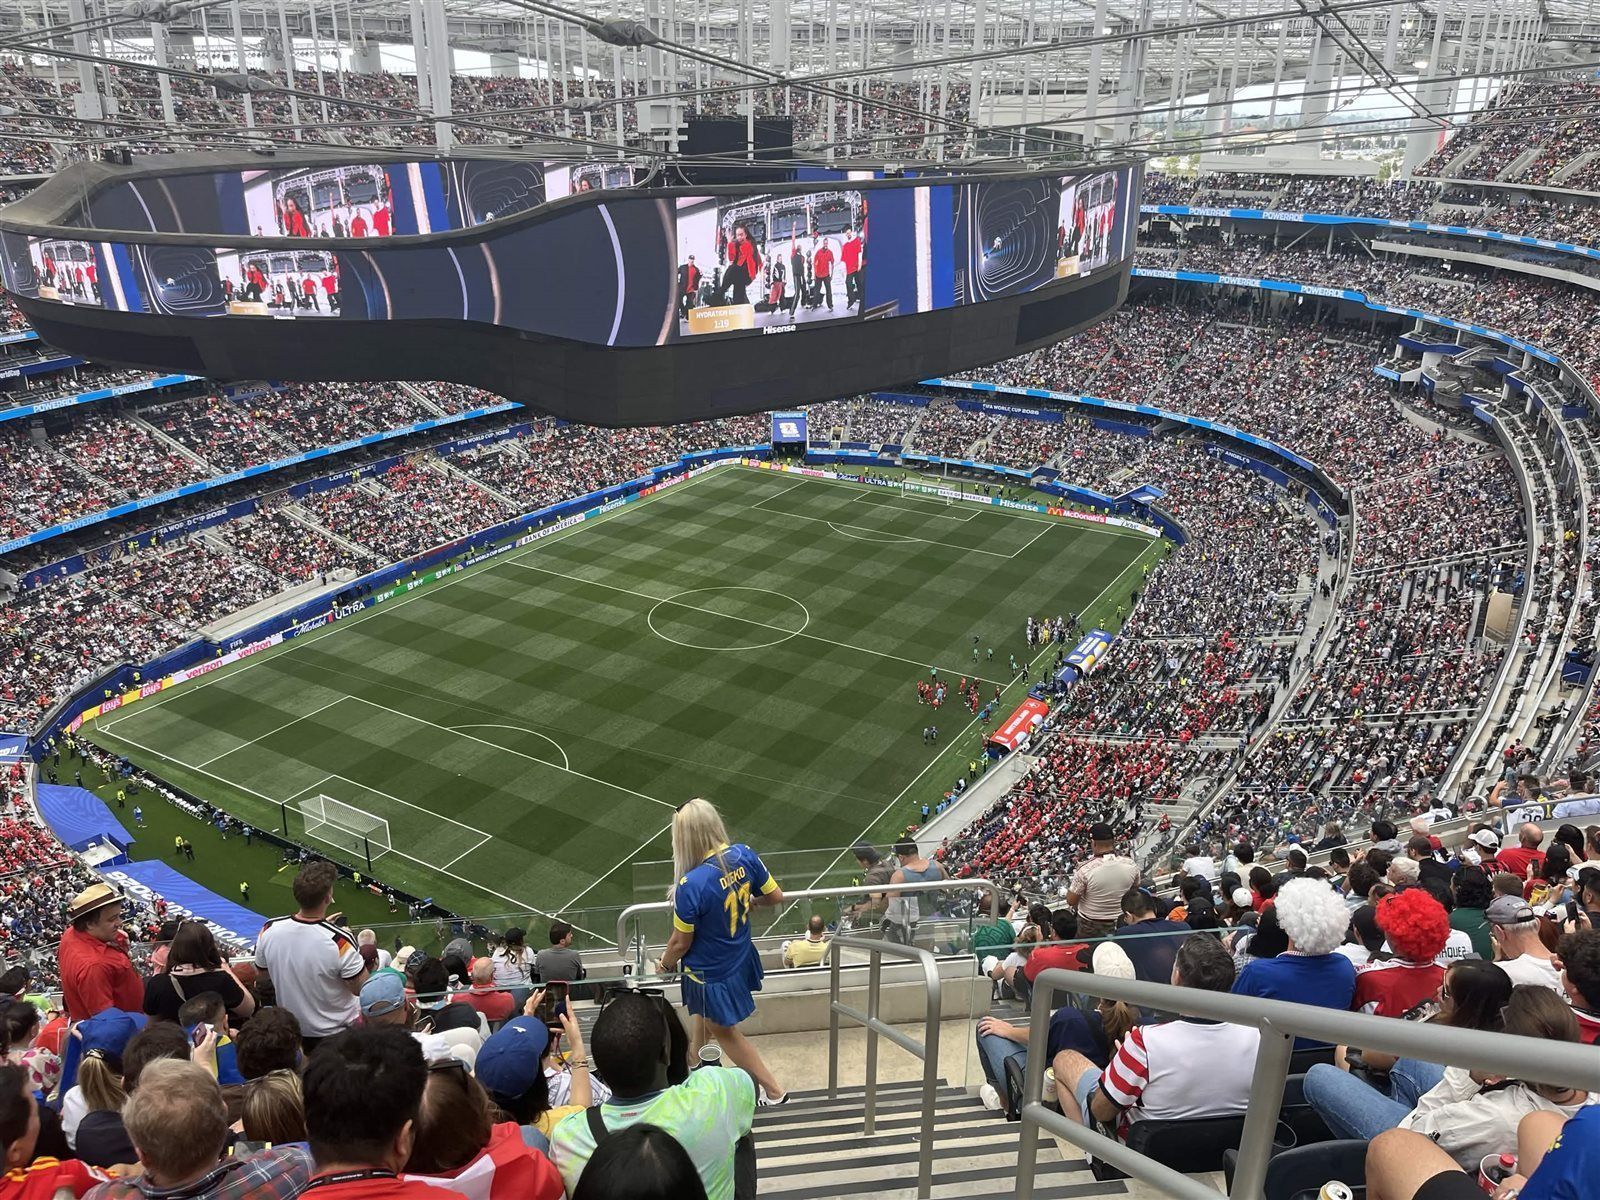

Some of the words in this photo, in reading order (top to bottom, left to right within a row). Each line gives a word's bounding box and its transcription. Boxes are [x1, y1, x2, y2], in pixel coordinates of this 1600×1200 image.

[1189, 207, 1231, 217] POWERADE
[1262, 211, 1304, 222] POWERADE
[1136, 268, 1177, 279] POWERADE
[1219, 275, 1261, 287] POWERADE
[1300, 285, 1344, 298] POWERADE
[763, 324, 796, 335] Hisense
[112, 381, 154, 396] POWERADE
[33, 397, 78, 413] POWERADE
[329, 474, 343, 482] LOS
[864, 478, 886, 487] ULTRA
[137, 491, 181, 509] POWERADE
[600, 498, 626, 514] Hisense
[1000, 499, 1038, 512] Hisense
[62, 512, 109, 533] POWERADE
[168, 520, 192, 532] WORD
[205, 509, 227, 520] 2026
[1063, 510, 1105, 523] McDonald's
[524, 532, 541, 544] BANK
[542, 528, 550, 537] OF
[551, 517, 577, 533] AMERICA
[294, 617, 327, 637] Michelob
[334, 601, 365, 620] ULTRA
[230, 639, 243, 649] FIFA
[238, 639, 272, 659] verizon
[185, 659, 223, 678] verizon
